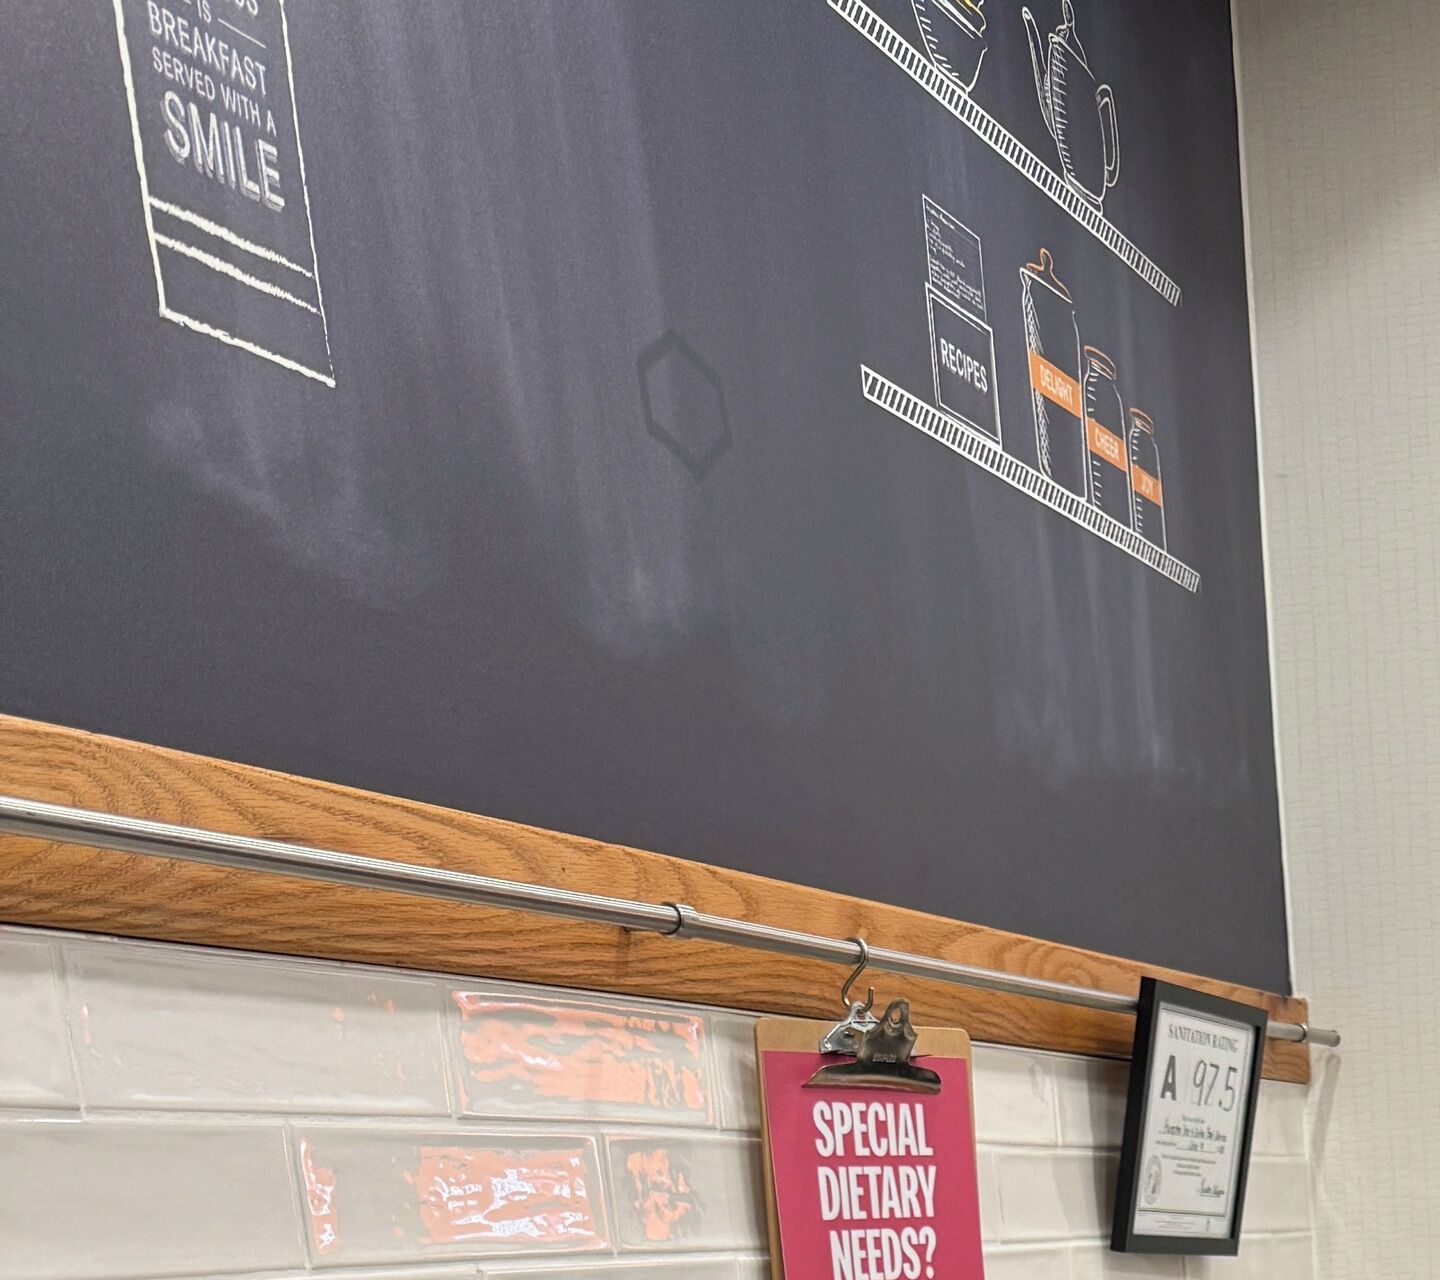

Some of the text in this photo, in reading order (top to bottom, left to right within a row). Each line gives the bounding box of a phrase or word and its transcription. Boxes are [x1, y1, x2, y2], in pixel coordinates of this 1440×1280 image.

[147, 0, 267, 97] BREAKFAST
[152, 46, 277, 137] SERVED WITH A
[160, 90, 285, 213] SMILE
[940, 337, 988, 394] RECIPES
[1039, 363, 1074, 406] DELIGHT
[1094, 432, 1121, 463] CHEER
[1140, 473, 1155, 500] JOY
[1160, 1054, 1238, 1112] A 97.5
[813, 1101, 934, 1157] SPECIAL
[817, 1165, 936, 1221] DIETARY
